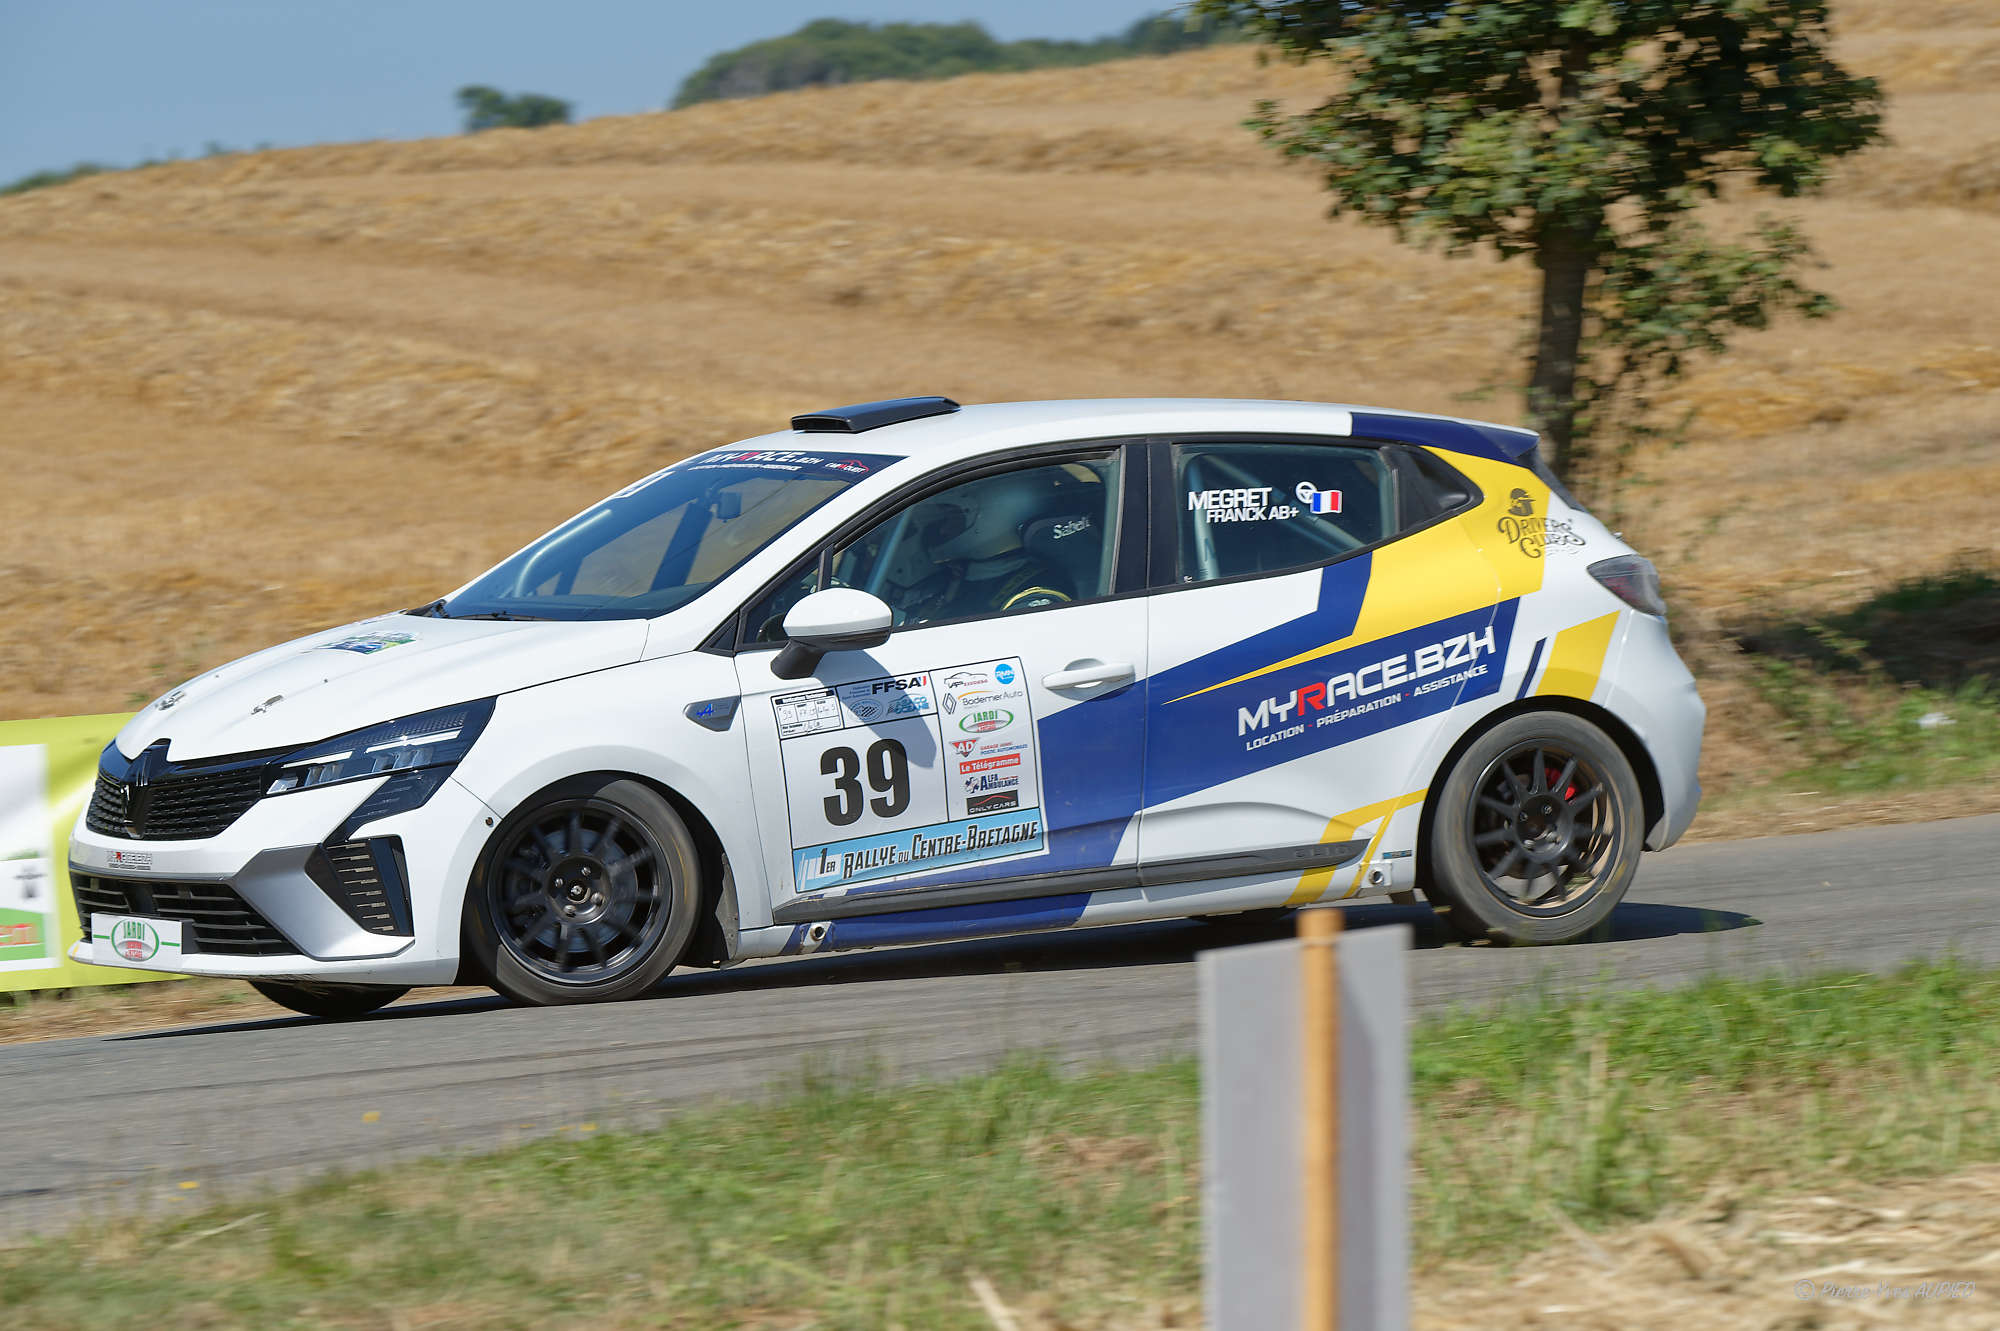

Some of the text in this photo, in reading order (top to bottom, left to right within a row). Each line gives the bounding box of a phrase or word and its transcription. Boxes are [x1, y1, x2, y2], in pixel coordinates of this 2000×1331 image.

[1188, 487, 1272, 511] MEGRET
[1206, 506, 1300, 523] FRANCK AB+
[871, 677, 922, 695] FFSA
[1238, 625, 1497, 736] MYRACE.BZH
[1246, 724, 1304, 751] LOCATION
[1316, 692, 1402, 728] PRÉPARATION
[1413, 664, 1488, 697] ASSISTANCE
[957, 742, 974, 754] AD
[961, 757, 1019, 773] Le Télégramme
[820, 738, 911, 827] 39
[969, 801, 1016, 813] ONLY CARS
[843, 845, 897, 880] RALLYE
[898, 850, 910, 863] DU
[911, 820, 1039, 854] CENTRE-BRETAGNE
